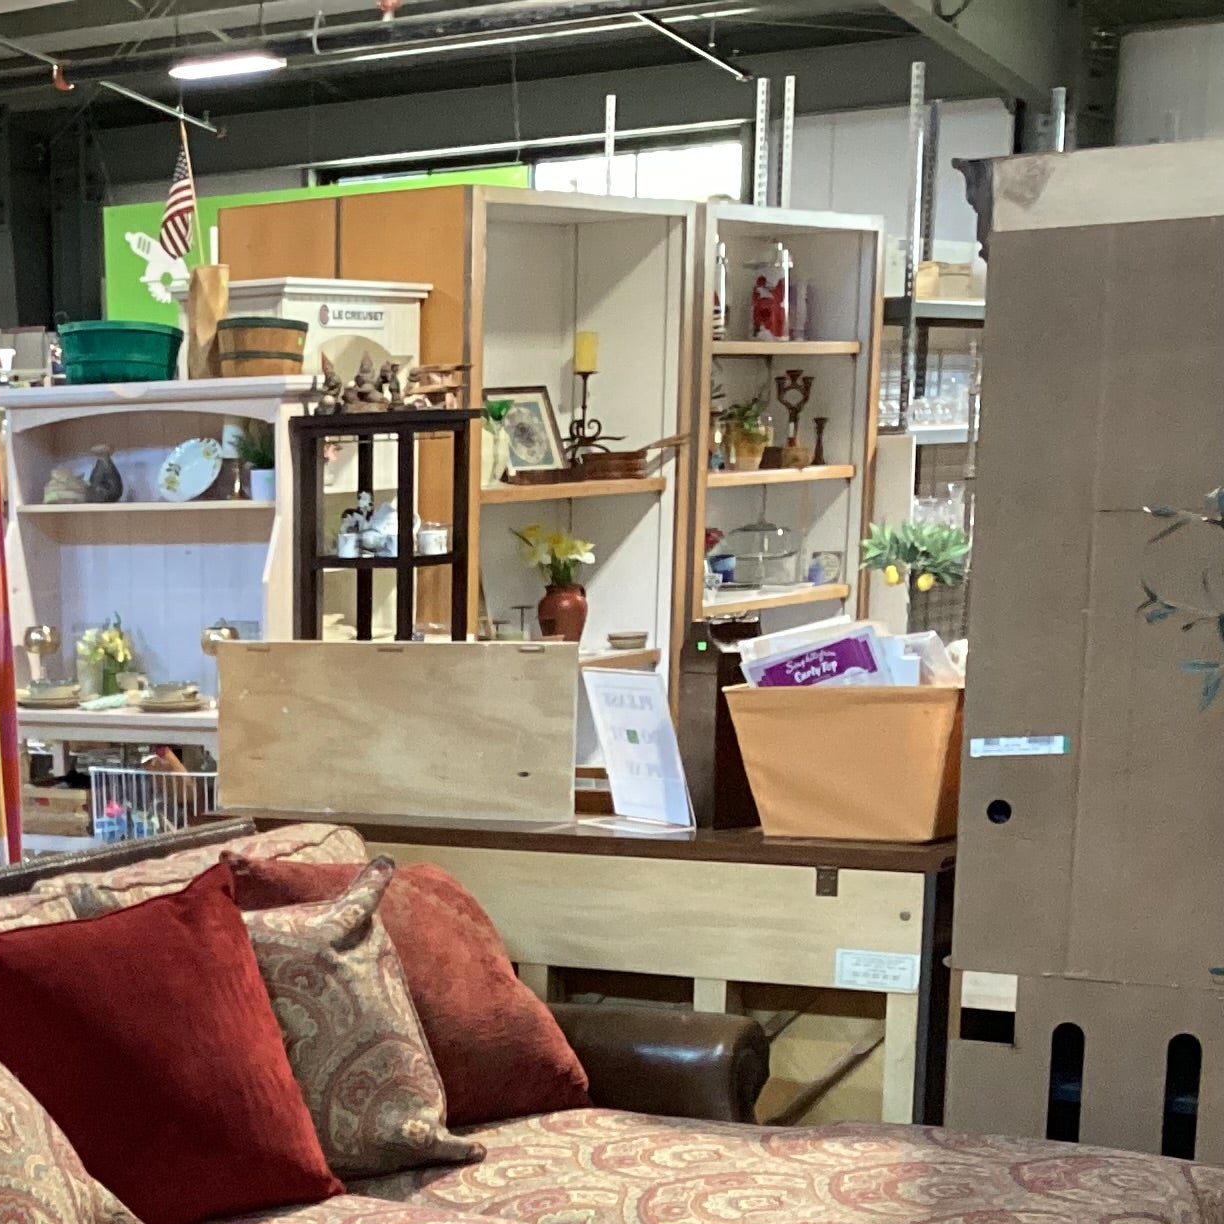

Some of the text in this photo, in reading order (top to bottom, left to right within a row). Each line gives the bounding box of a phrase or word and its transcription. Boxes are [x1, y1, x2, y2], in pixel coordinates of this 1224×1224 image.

[332, 311, 384, 321] LE CREUSET
[821, 660, 838, 673] Top
